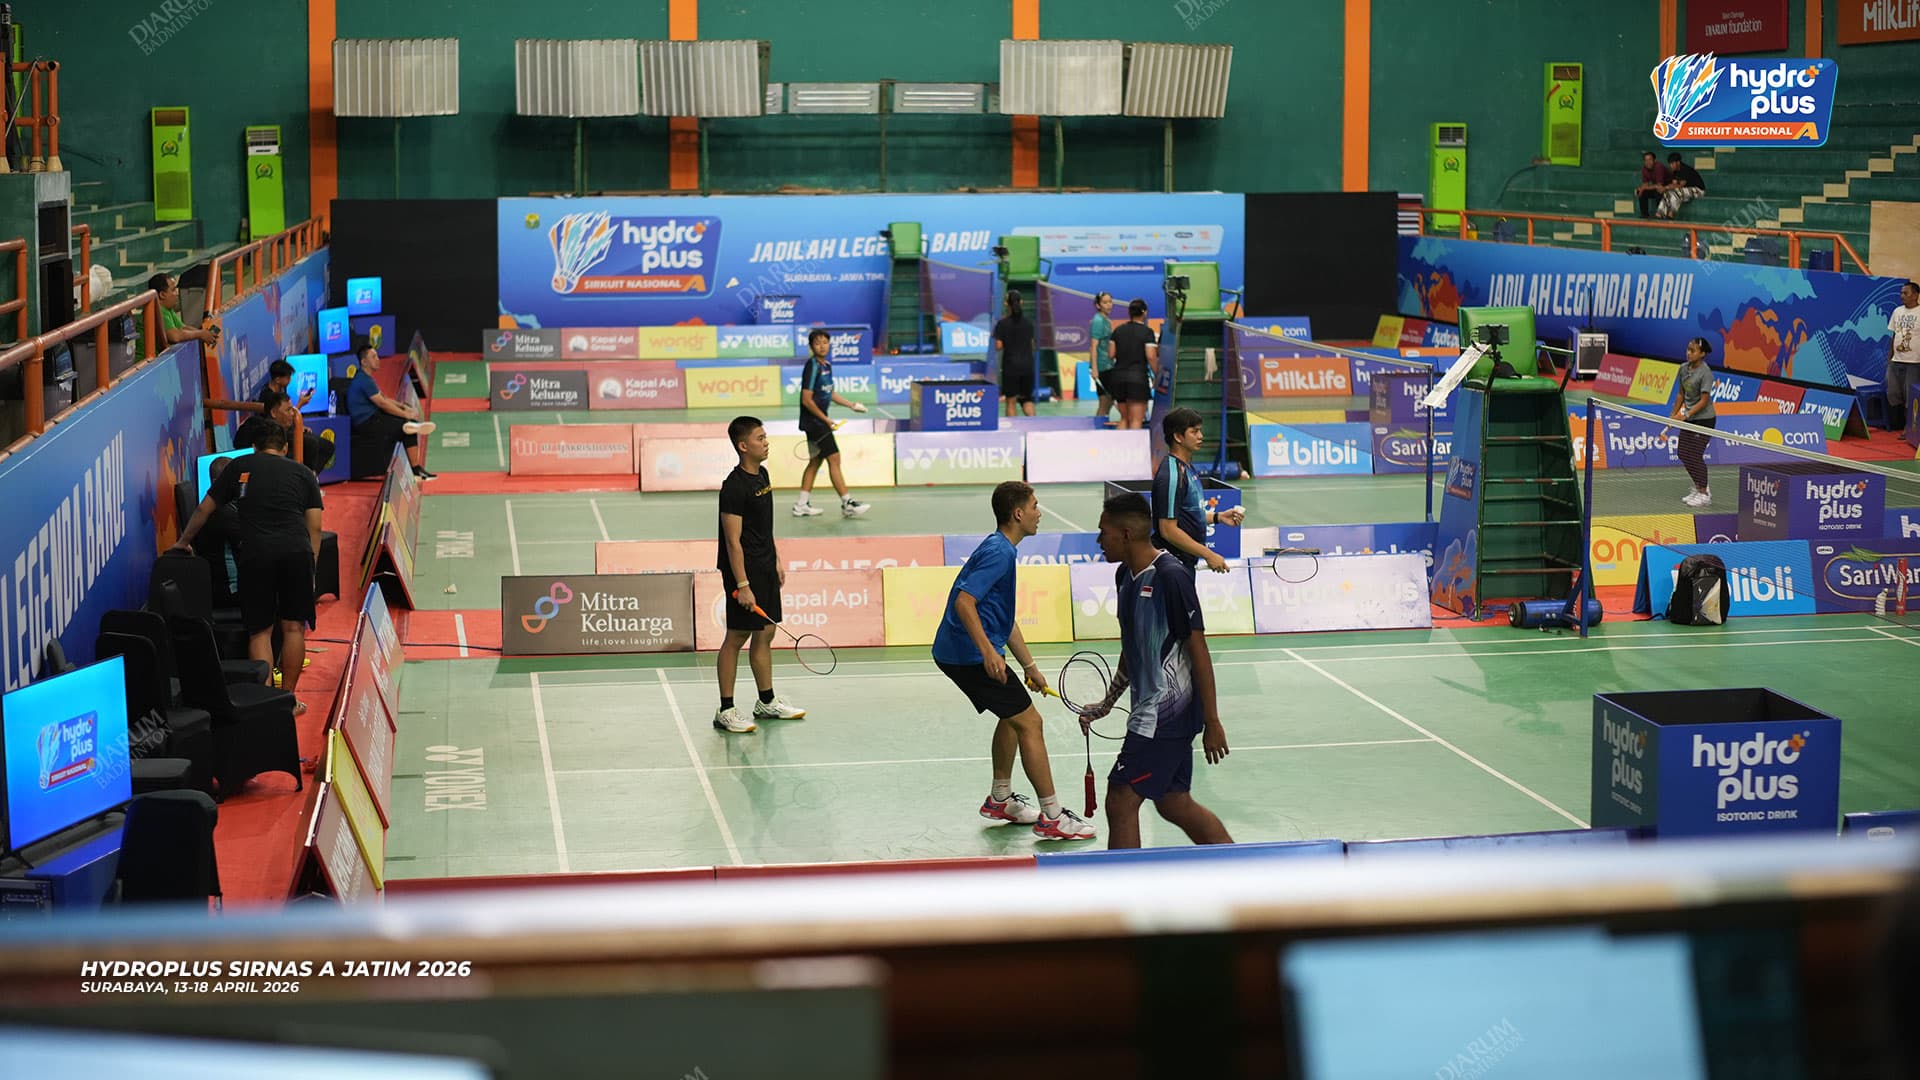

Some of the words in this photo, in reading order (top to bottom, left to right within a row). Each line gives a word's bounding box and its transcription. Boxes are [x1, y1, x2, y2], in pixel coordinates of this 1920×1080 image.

[1863, 0, 1920, 32] MilkLif
[623, 220, 703, 250] hydro
[749, 239, 837, 263] JADILAH
[932, 230, 991, 252] BARU!
[642, 248, 703, 273] plus
[584, 279, 624, 290] SIRKUIT
[627, 278, 682, 289] NASIONAL
[1553, 273, 1633, 319] LEGENDA
[1633, 273, 1694, 320] BARU!
[515, 334, 540, 344] Mitra
[747, 335, 789, 348] YONEX
[830, 333, 860, 347] ydro
[967, 328, 990, 347] bli
[1283, 326, 1307, 337] com
[515, 343, 554, 354] Keluarga
[530, 379, 560, 389] Mitra
[625, 378, 656, 390] Kapal
[657, 377, 678, 390] Api
[697, 376, 768, 393] wondr
[1265, 369, 1346, 390] MilkLife
[530, 389, 578, 402] Keluarga
[625, 389, 657, 400] Group
[935, 389, 981, 411] hydro
[946, 405, 982, 421] plus
[1609, 431, 1680, 455] hydrop
[1784, 431, 1820, 445] com
[945, 447, 1014, 469] YONEX
[1293, 440, 1358, 466] blibli
[1747, 472, 1778, 498] hydro
[1806, 480, 1864, 504] hydro
[85, 430, 126, 591] BARU!
[1753, 495, 1777, 517] plus
[1818, 500, 1862, 523] plus
[580, 592, 640, 611] Mitra
[782, 589, 828, 609] apal
[832, 588, 869, 609] Api
[580, 613, 674, 636] Keluarga
[782, 612, 828, 628] roup
[62, 719, 93, 745] hydro
[1603, 709, 1645, 760] hydro
[70, 738, 94, 762] plus
[1692, 732, 1800, 776] hydro
[1611, 753, 1643, 794] plus
[1717, 768, 1799, 810] plus
[1717, 811, 1765, 822] ISOTONIC
[1767, 810, 1798, 820] DRINK
